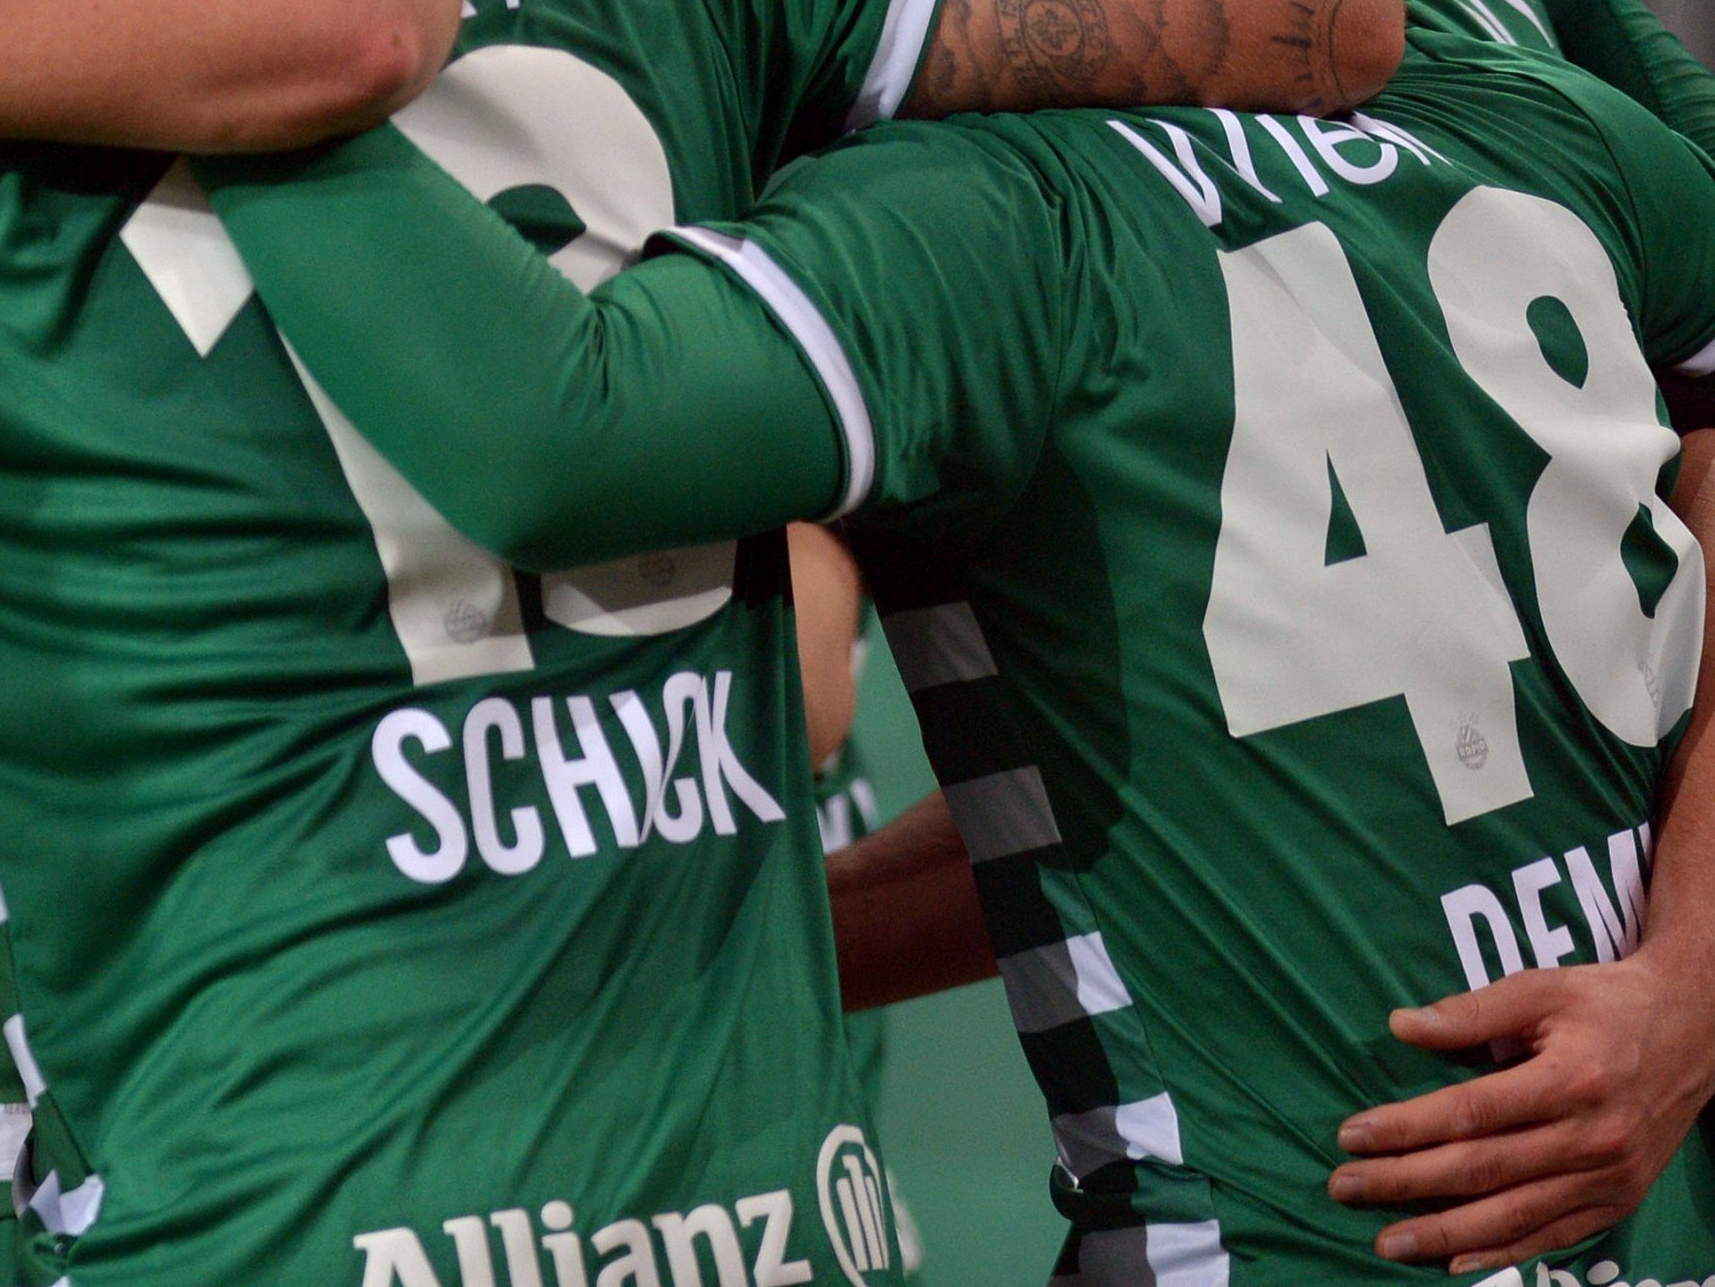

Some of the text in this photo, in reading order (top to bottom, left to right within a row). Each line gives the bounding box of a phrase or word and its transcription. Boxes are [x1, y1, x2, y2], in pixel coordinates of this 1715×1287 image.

[1201, 184, 1708, 827] 48
[371, 670, 786, 884] SCHICK
[1439, 821, 1653, 1063] DEM
